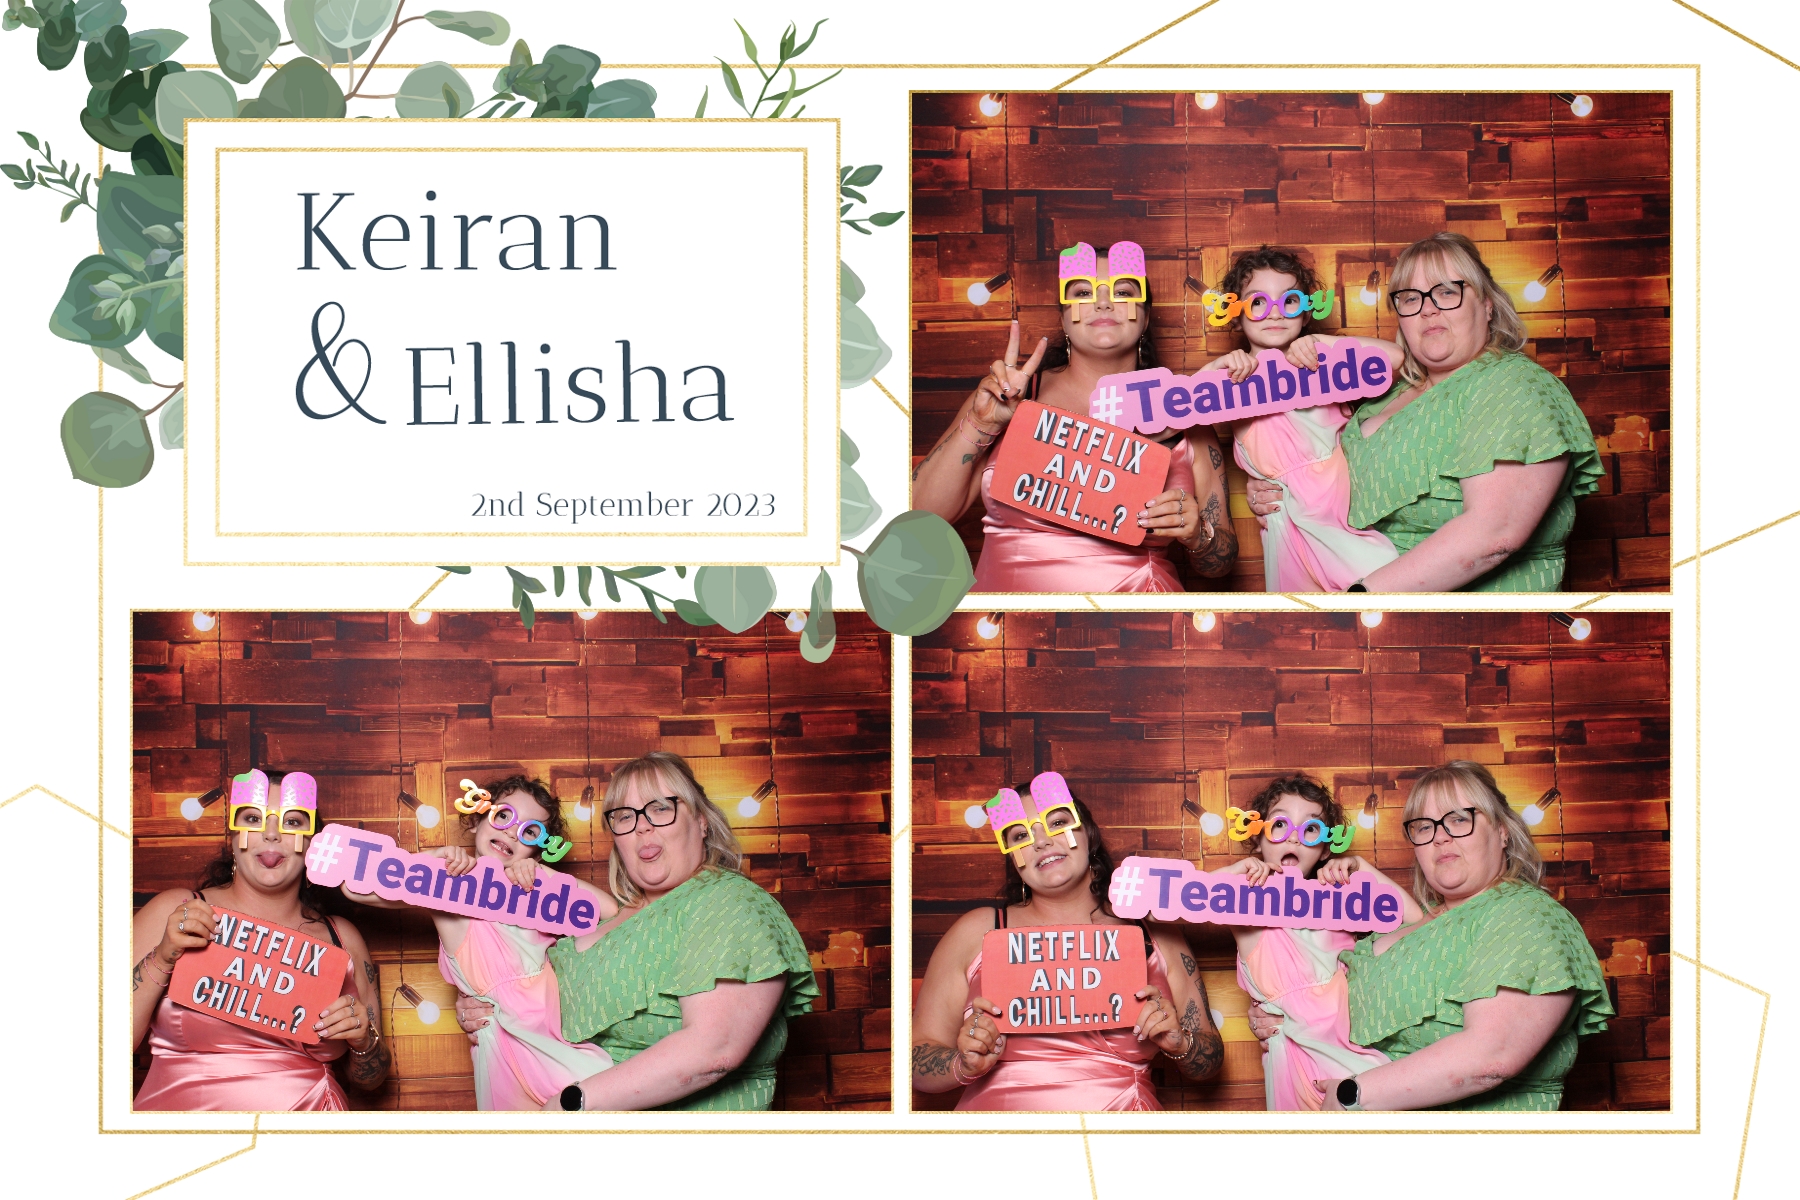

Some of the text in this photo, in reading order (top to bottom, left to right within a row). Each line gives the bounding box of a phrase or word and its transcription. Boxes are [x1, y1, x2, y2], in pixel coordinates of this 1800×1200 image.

[1034, 409, 1148, 474] NETFLIX
[1043, 453, 1116, 493] AND
[1013, 473, 1127, 535] CHILL...?
[213, 913, 327, 976] NETFLIX
[1008, 930, 1120, 964] NETFLIX
[223, 956, 295, 995] AND
[1030, 967, 1102, 991] AND
[192, 976, 306, 1034] CHILL...?
[1008, 993, 1123, 1027] CHILL...?
